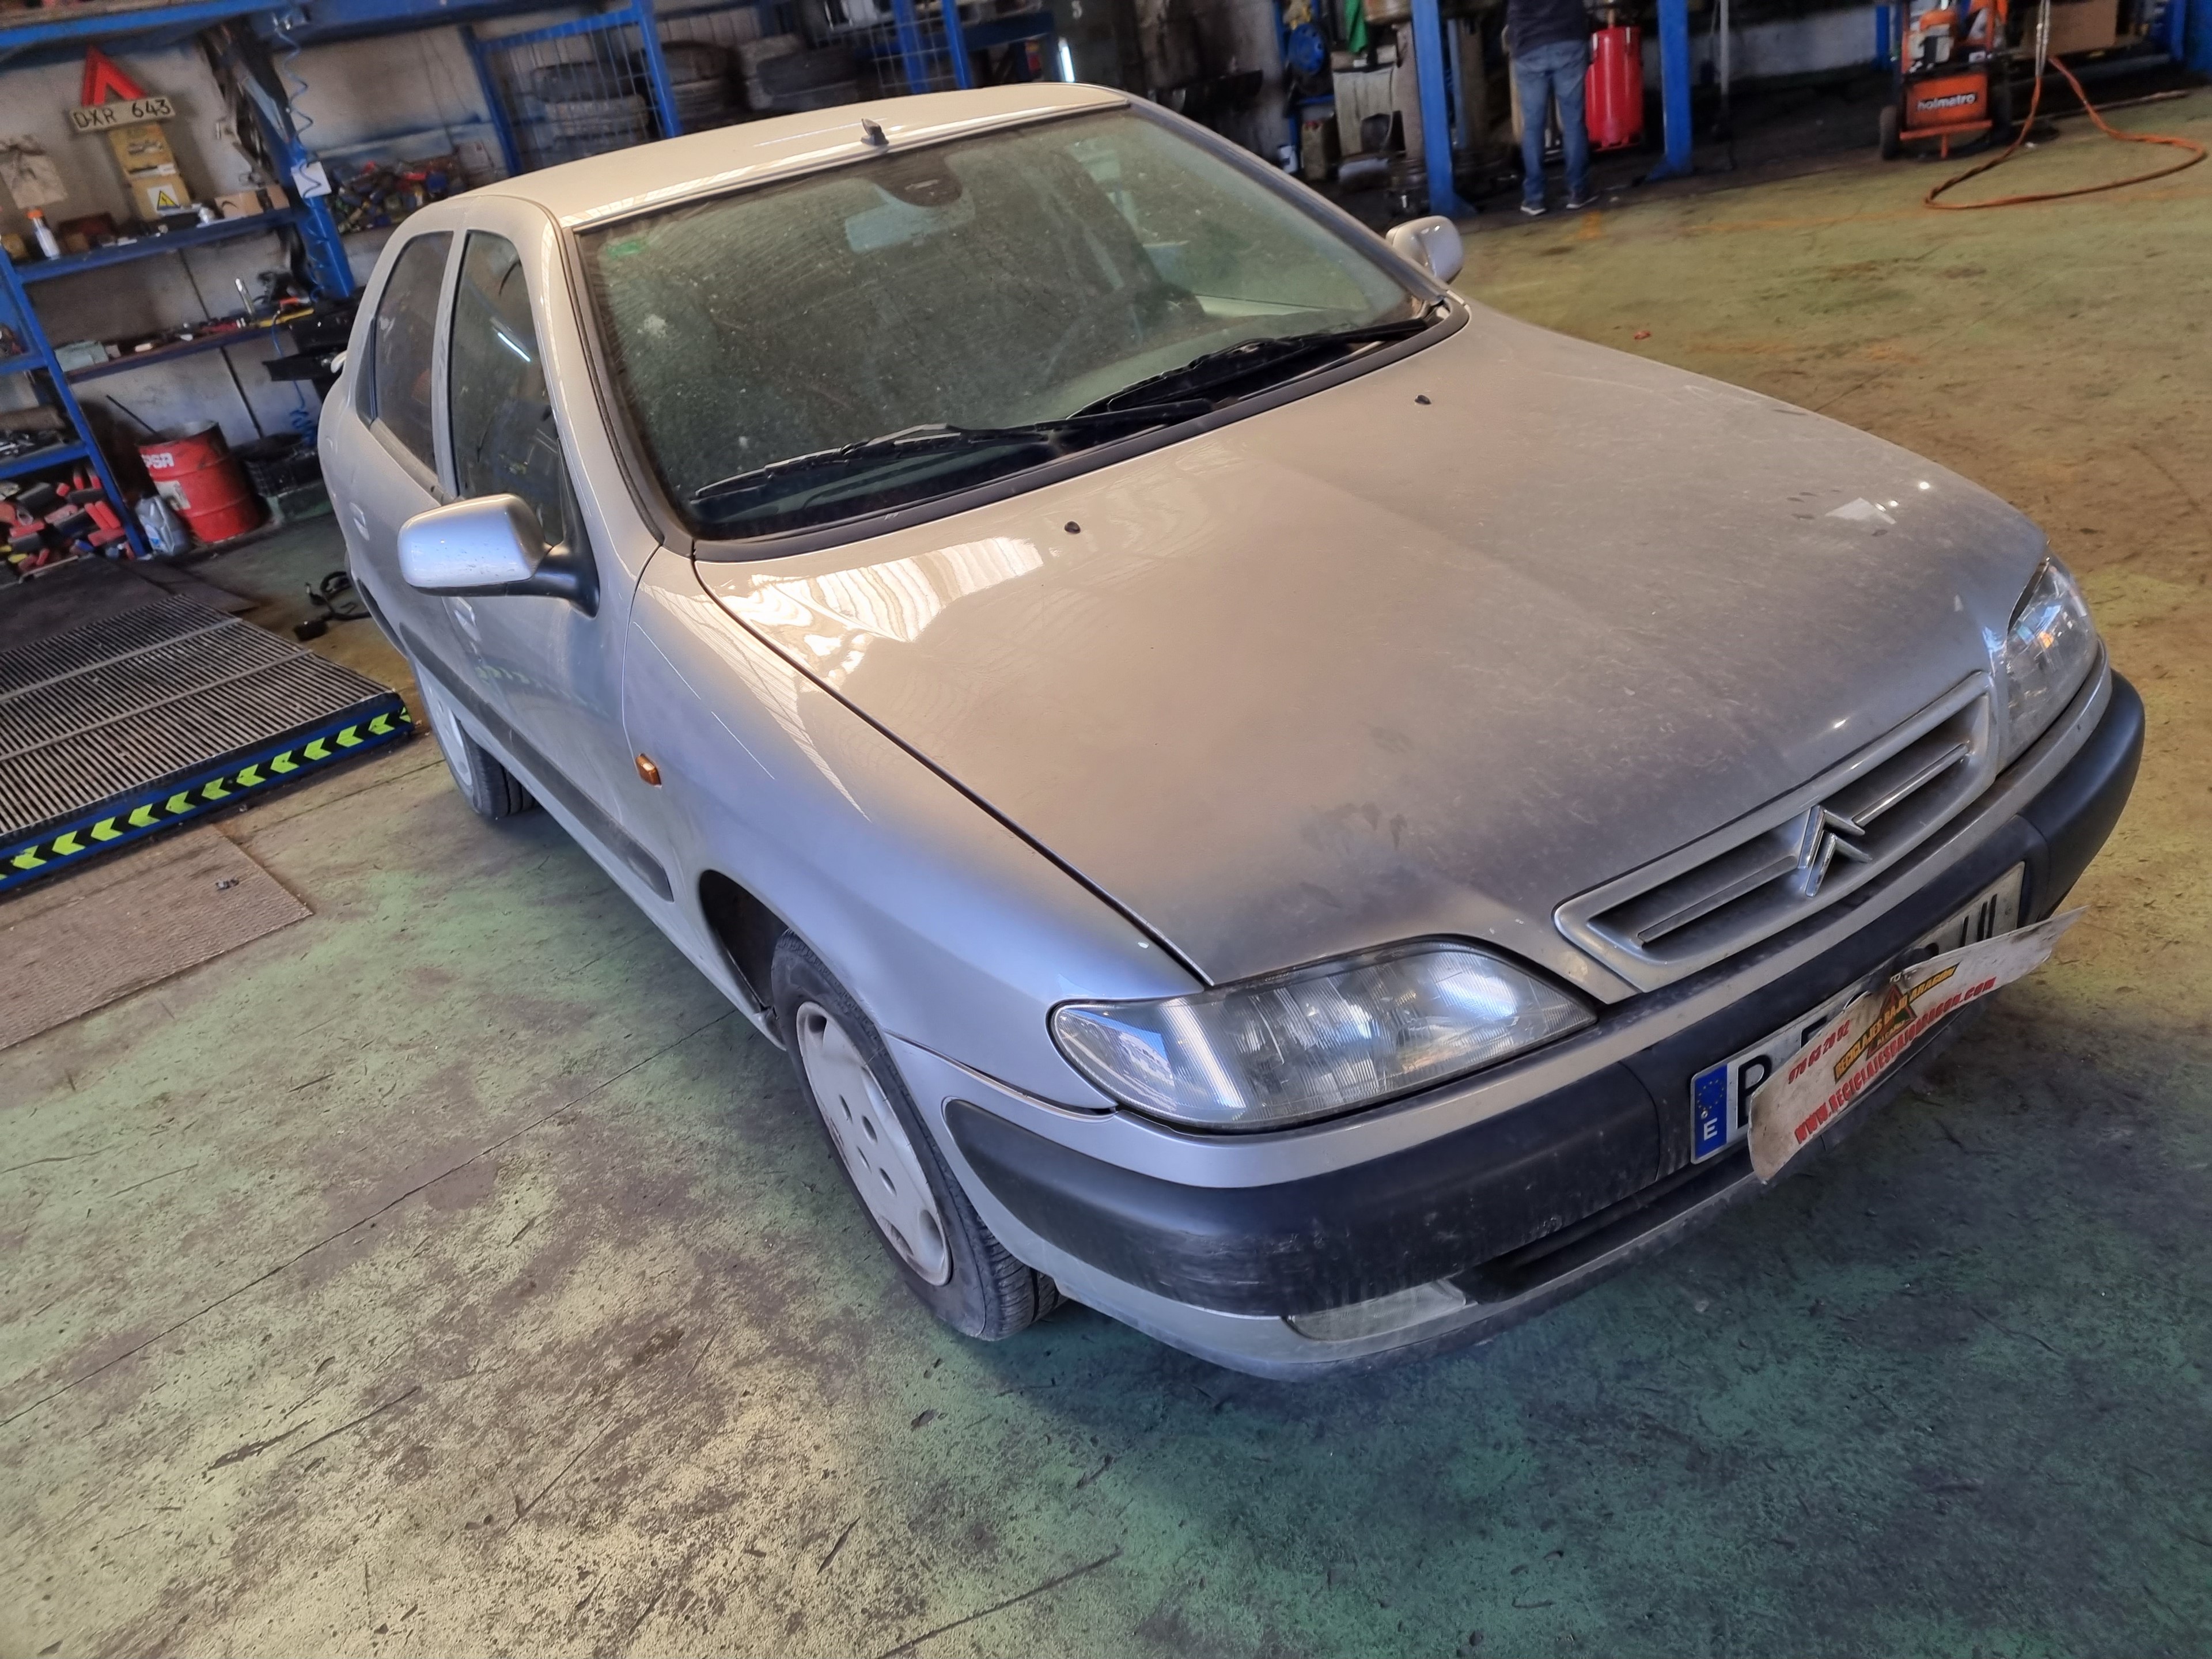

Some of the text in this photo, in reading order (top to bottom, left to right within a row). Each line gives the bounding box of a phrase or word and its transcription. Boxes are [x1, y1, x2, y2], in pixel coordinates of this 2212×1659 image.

[73, 99, 171, 128] DXR 643
[1917, 93, 1976, 111] holmatro
[1835, 1017, 1883, 1077] RECICLAJES
[1884, 994, 1908, 1026] BAJO
[1703, 1117, 1718, 1141] E
